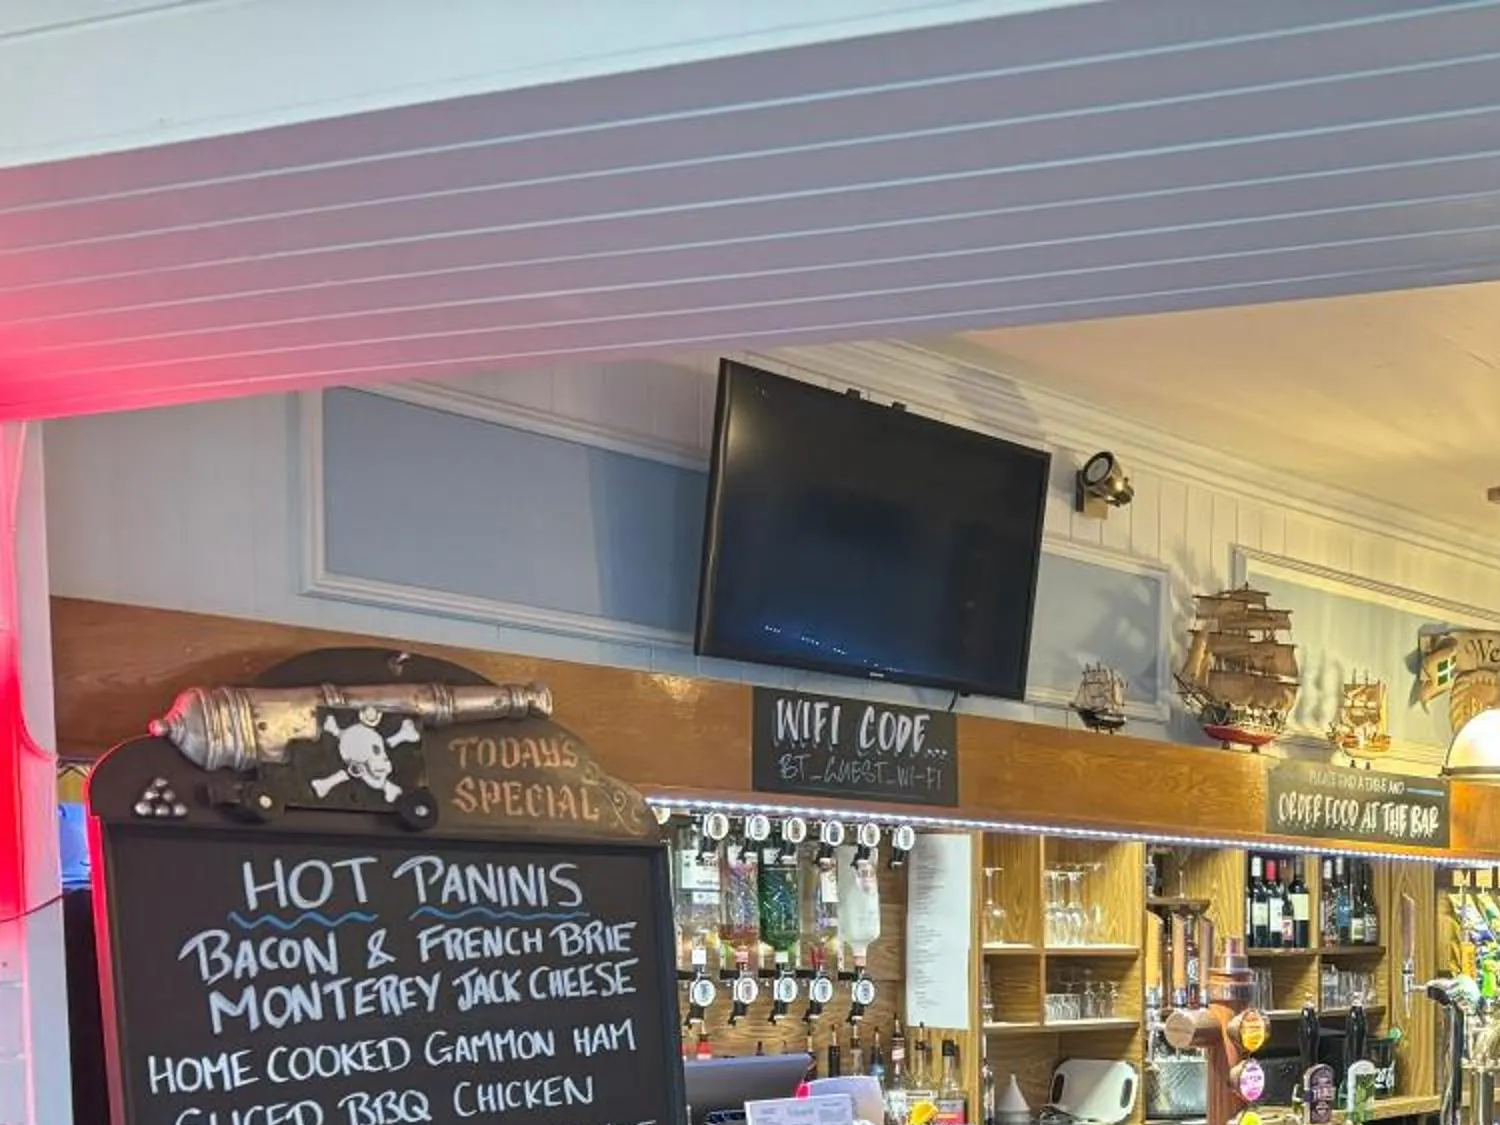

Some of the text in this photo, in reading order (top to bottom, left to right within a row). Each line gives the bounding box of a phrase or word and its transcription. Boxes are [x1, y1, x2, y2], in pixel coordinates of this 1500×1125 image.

[774, 698, 841, 746] WIFI
[1278, 791, 1440, 836] ORDER FOOD AT THE BAR
[242, 855, 584, 911] HOT PANINIS
[178, 920, 639, 985] BACON & FRENCH BRIE
[208, 958, 639, 1035] MONTEREY JACK CHEESE
[147, 1018, 636, 1095] HOME COOKED GAMMON HAM
[453, 1074, 594, 1118] CHICKEN
